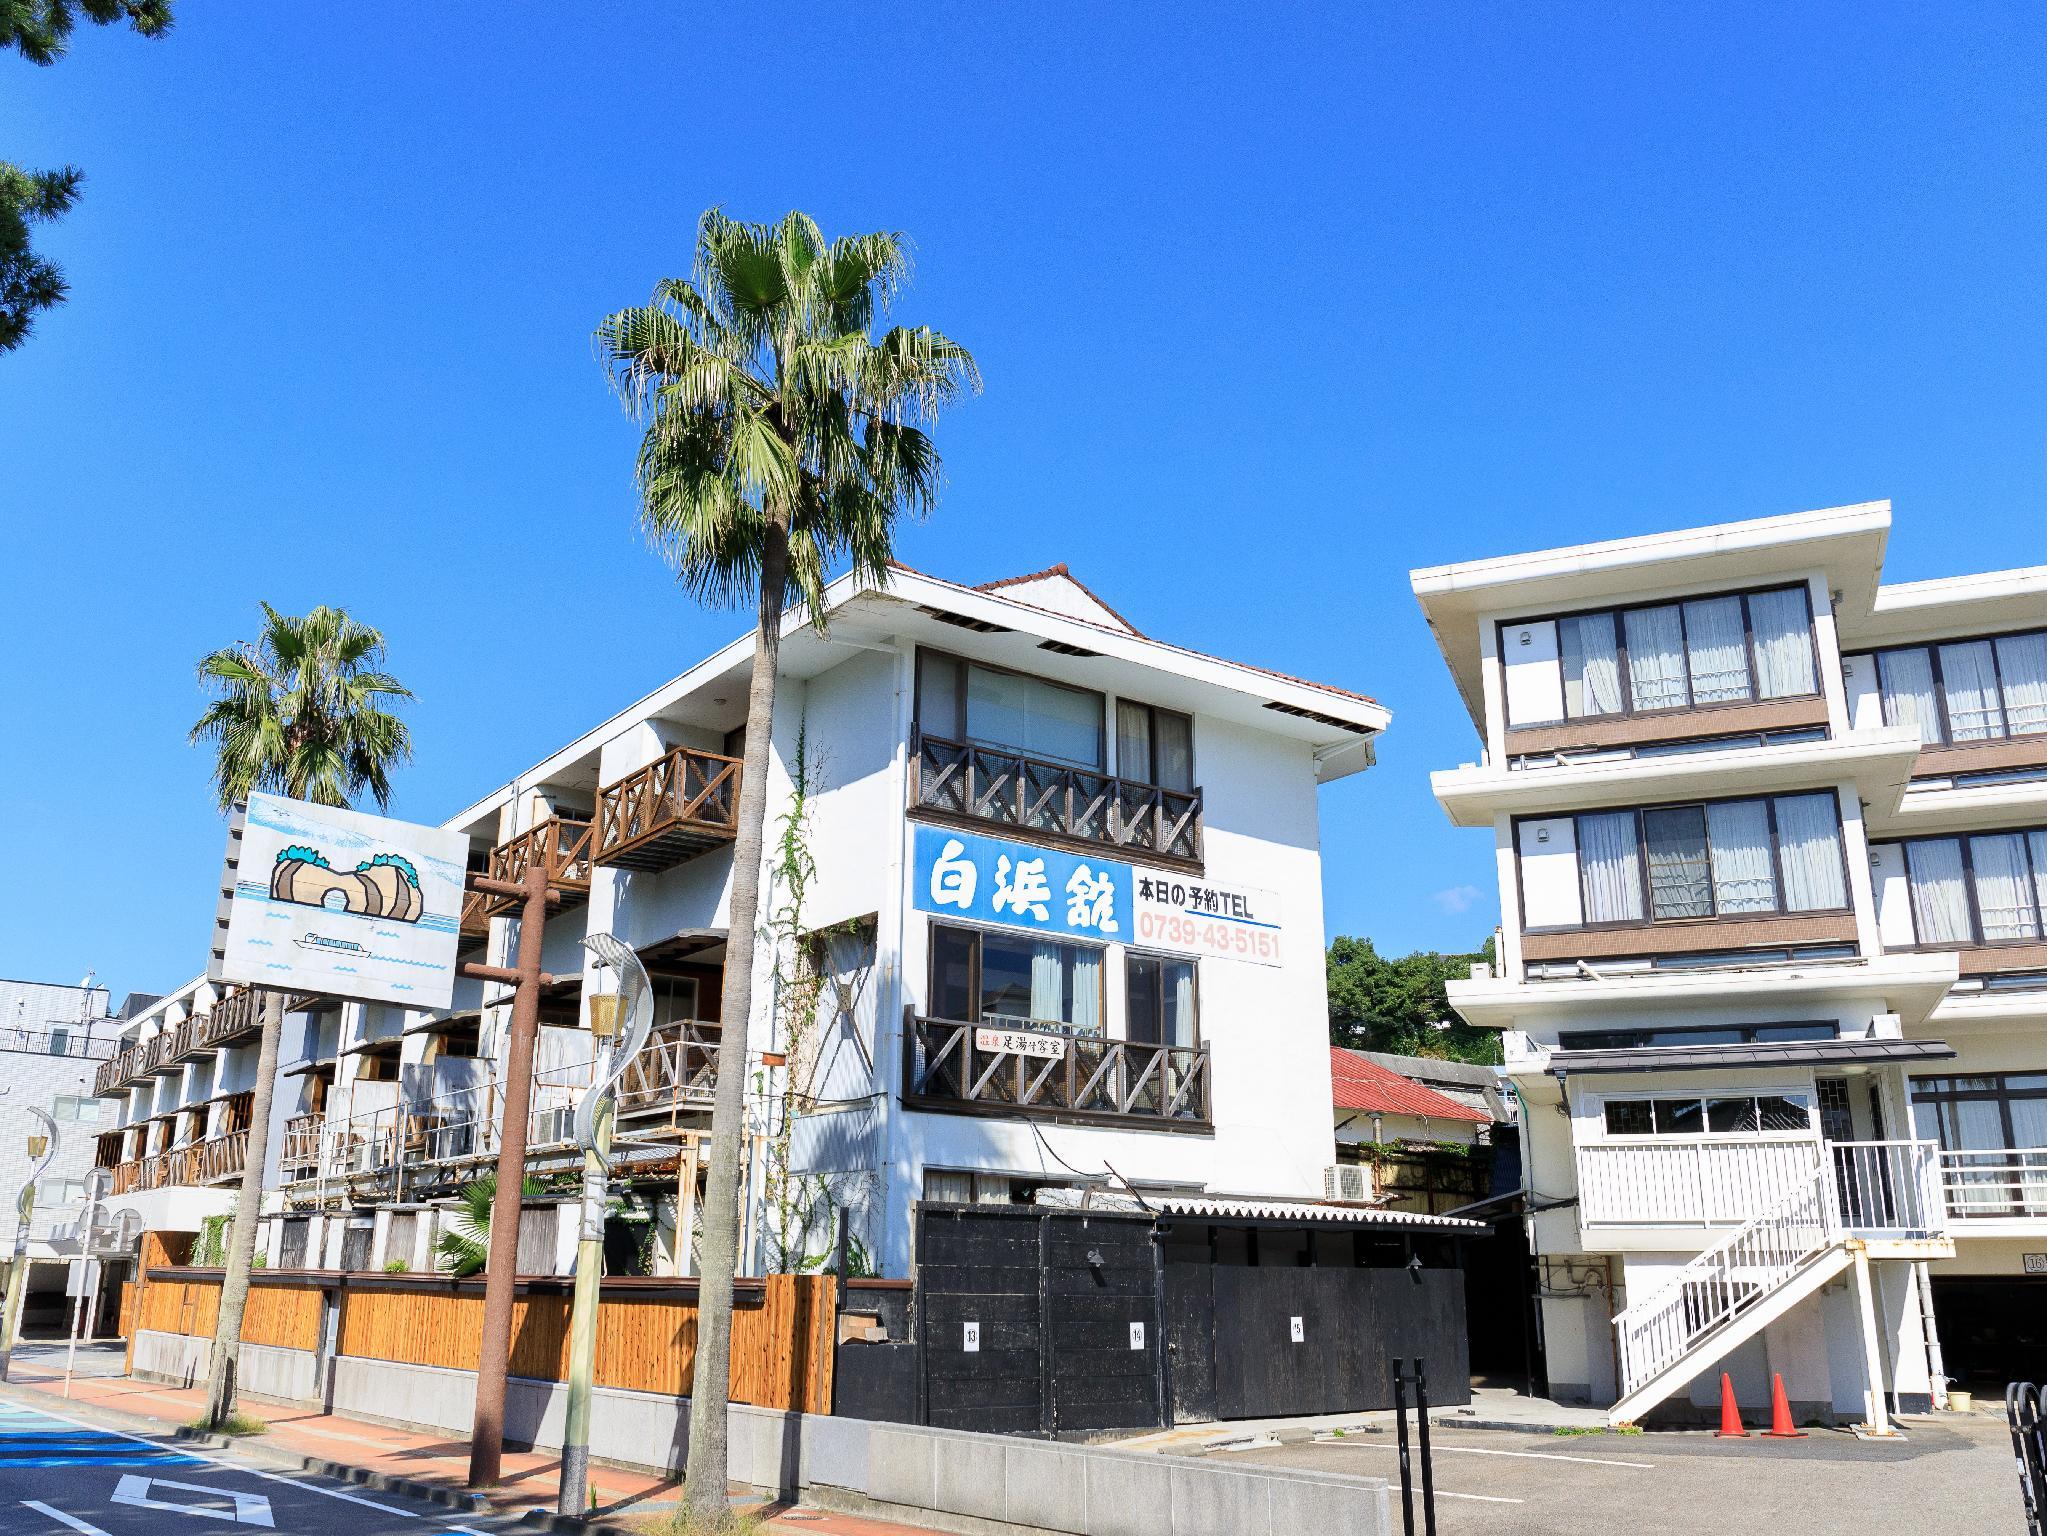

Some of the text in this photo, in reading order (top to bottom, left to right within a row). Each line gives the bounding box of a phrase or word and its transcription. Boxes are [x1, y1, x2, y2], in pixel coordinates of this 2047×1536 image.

[1139, 876, 1254, 919] 本日の予約TEL
[2029, 1257, 2043, 1269] 16
[967, 1330, 976, 1342] 13
